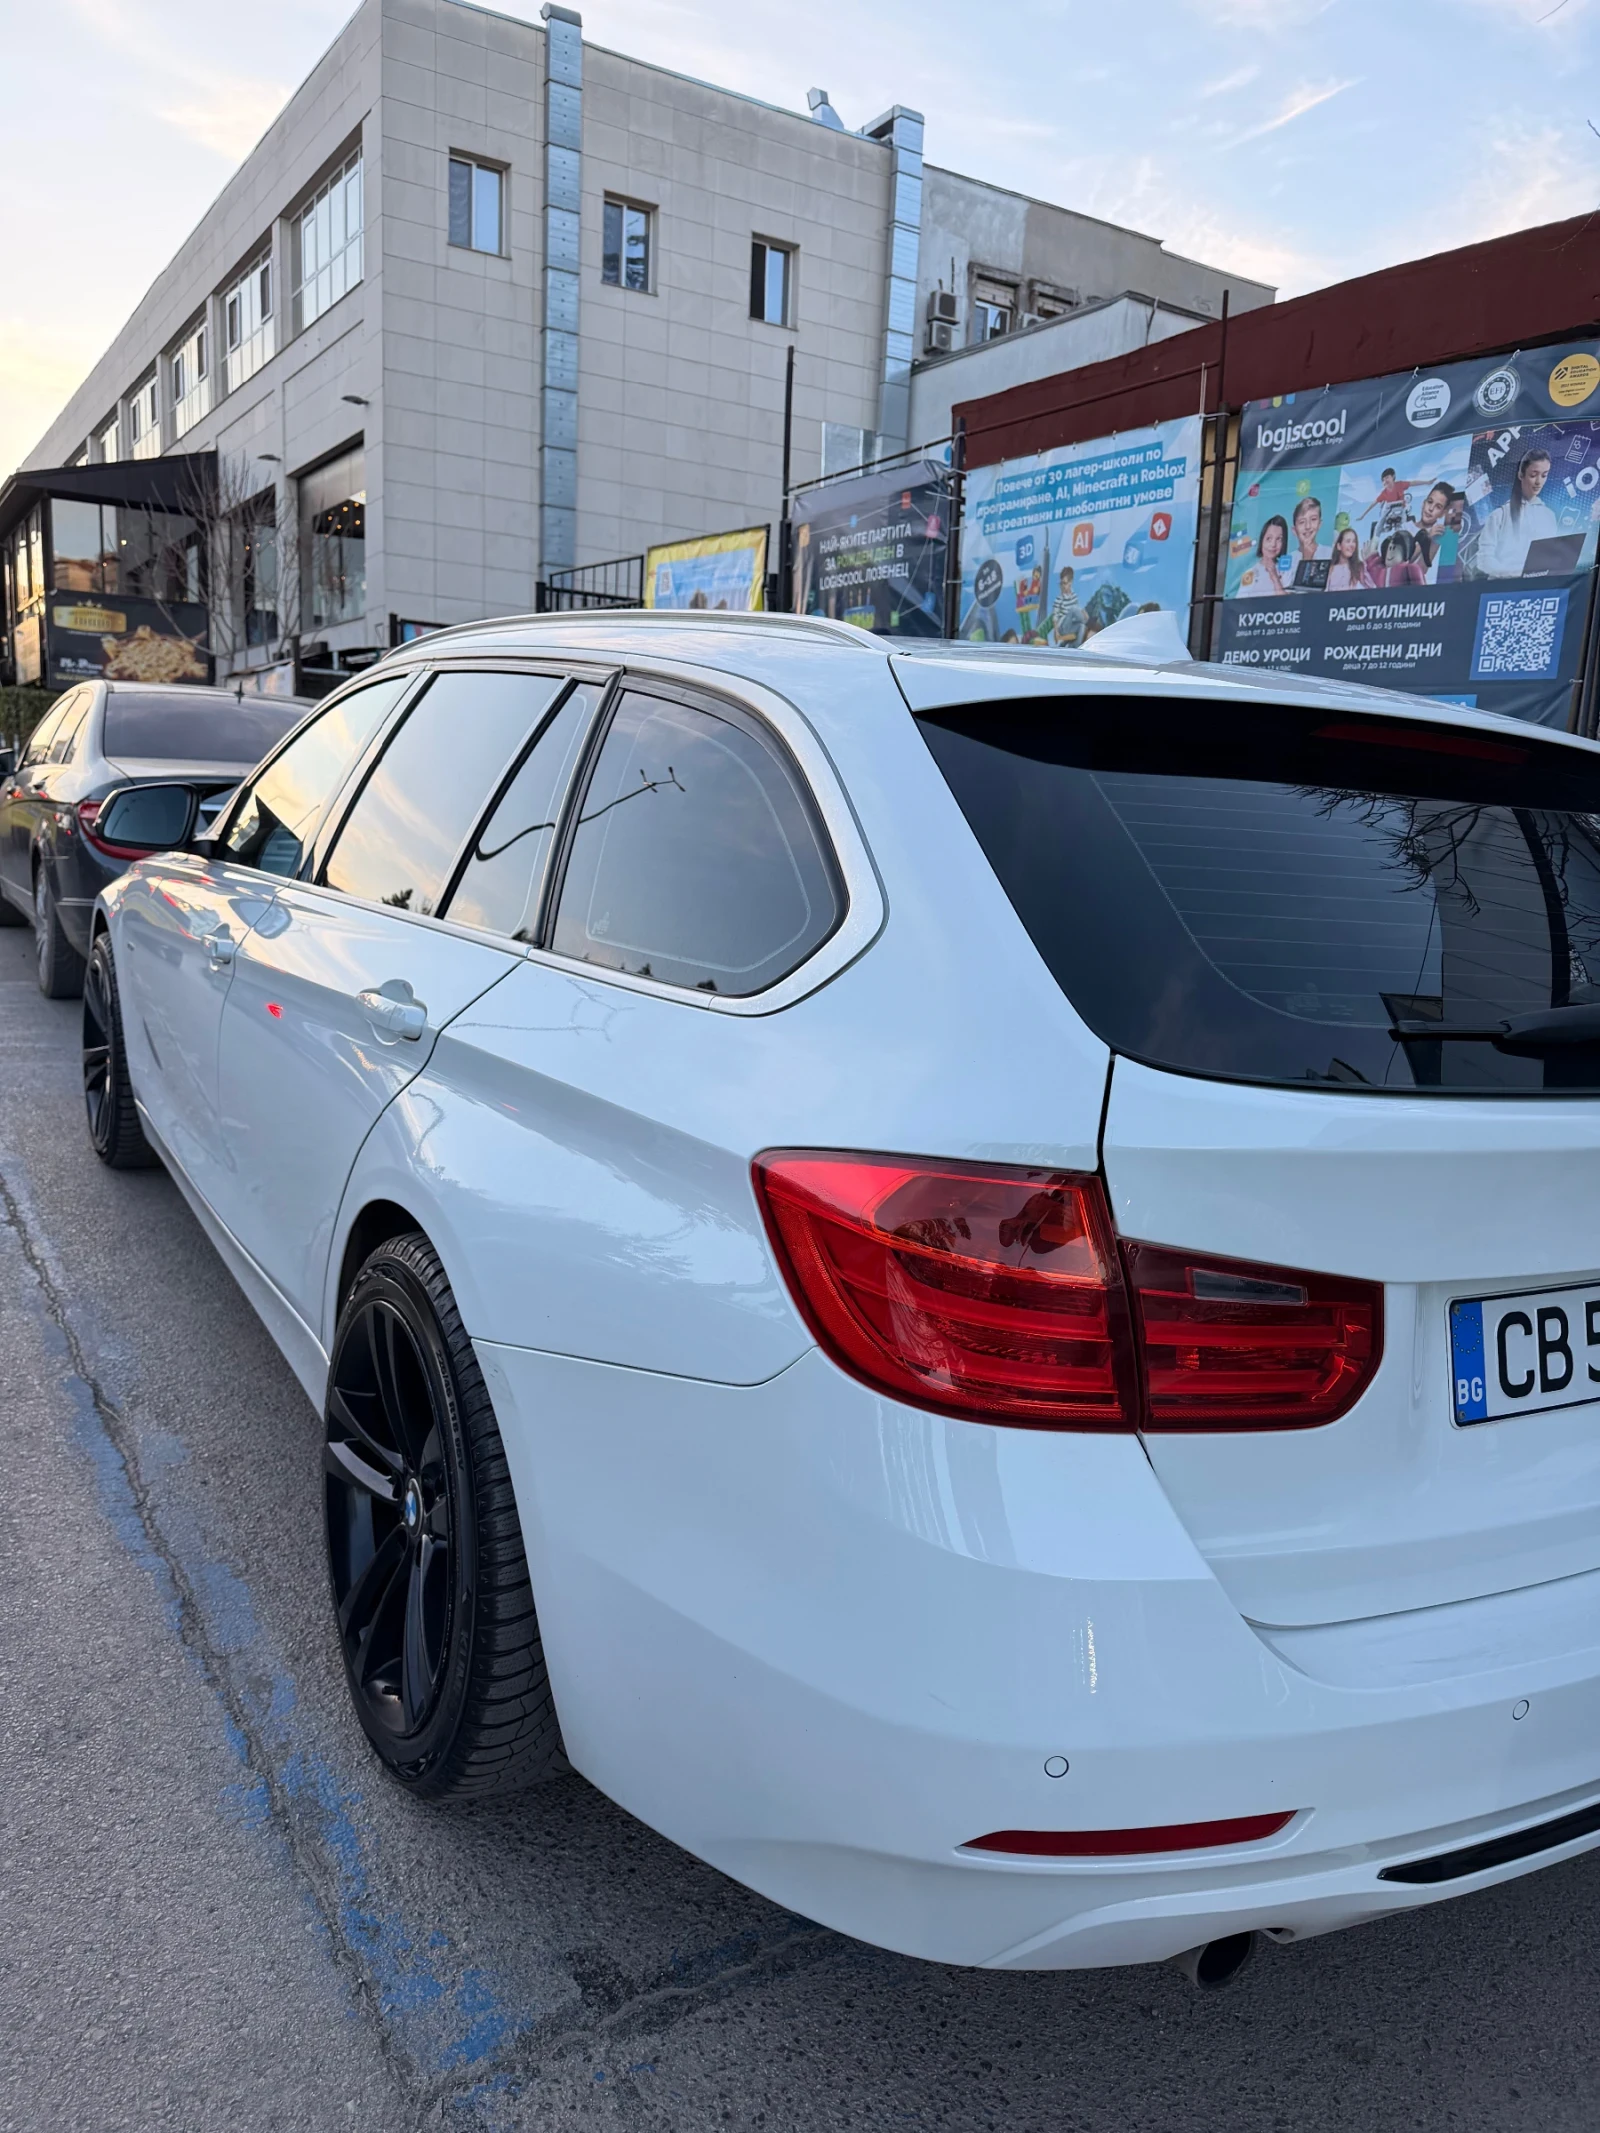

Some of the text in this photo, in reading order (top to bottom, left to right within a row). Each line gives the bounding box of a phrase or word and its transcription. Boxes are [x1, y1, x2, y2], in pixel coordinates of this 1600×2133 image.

[1257, 409, 1347, 452] logiscool
[1306, 439, 1325, 447] Code.
[1325, 436, 1344, 445] Enjoy.
[996, 448, 1162, 494] Повече от 30 лагер-школи по
[977, 463, 1185, 518] програмиране, AI, Minecraft и Roblox
[984, 486, 1173, 534] за креативни и любопитни умове
[868, 523, 911, 543] ПАРТИТА
[1074, 531, 1090, 549] AI
[824, 556, 836, 572] ЗА
[896, 543, 905, 558] В
[1019, 543, 1033, 559] 3D
[820, 570, 864, 590] LOGISCOOL
[1238, 610, 1301, 627] КУРСОВЕ
[1328, 601, 1446, 622] РАБОТИЛНИЦИ
[1346, 621, 1422, 632] деца 6 до 15 години
[1222, 647, 1311, 665] ДЕМО УРОЦИ
[1323, 642, 1442, 662] РОЖДЕНИ ДНИ
[1342, 661, 1416, 671] деца 7 до 12 години
[1497, 1306, 1574, 1399] CB
[1457, 1377, 1483, 1405] BG
